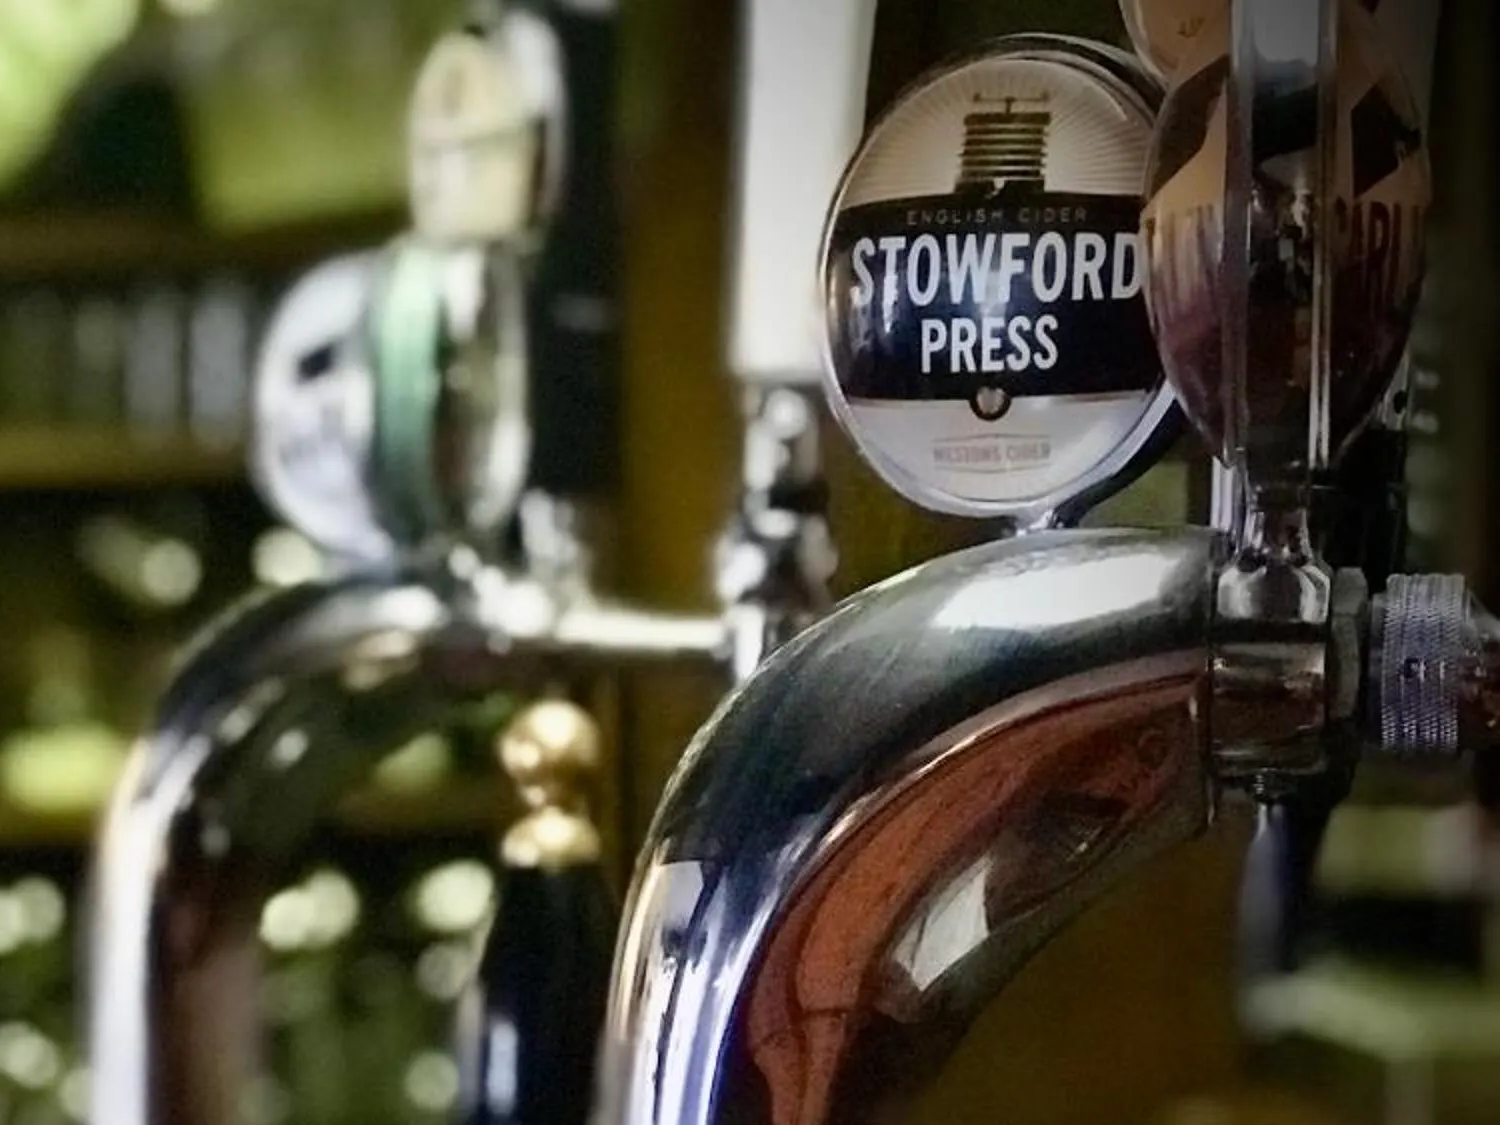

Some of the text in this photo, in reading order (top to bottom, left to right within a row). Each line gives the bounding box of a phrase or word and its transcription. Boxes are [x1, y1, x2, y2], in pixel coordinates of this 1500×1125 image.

[906, 205, 1088, 226] ENGLISH CIDER
[850, 231, 1145, 306] STOWFORD
[921, 314, 1059, 374] PRESS
